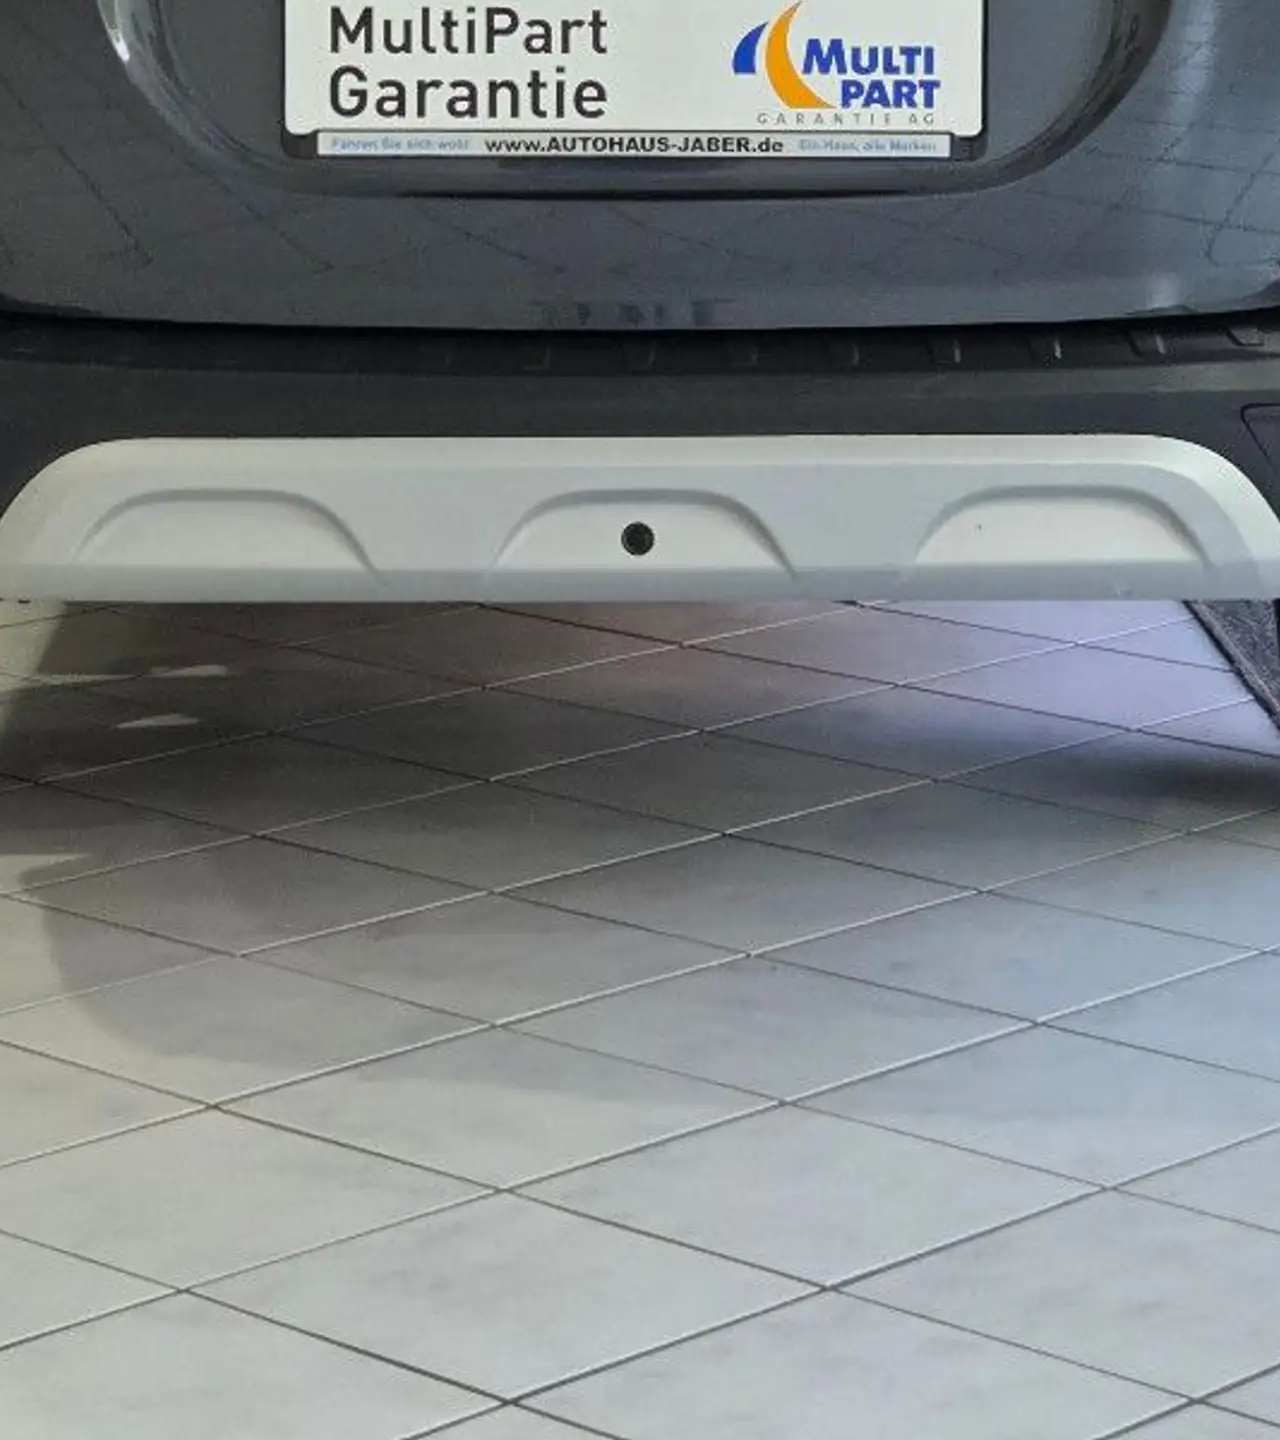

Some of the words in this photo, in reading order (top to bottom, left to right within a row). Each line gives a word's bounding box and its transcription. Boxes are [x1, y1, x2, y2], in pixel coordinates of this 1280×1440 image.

[329, 6, 608, 54] MultiPart
[802, 38, 936, 75] MULTI
[329, 65, 608, 119] Garantie
[840, 79, 942, 109] PART
[756, 112, 891, 125] GARANTIE
[908, 112, 935, 125] AG
[483, 136, 784, 153] www.AUTOHAUS-JABER.de
